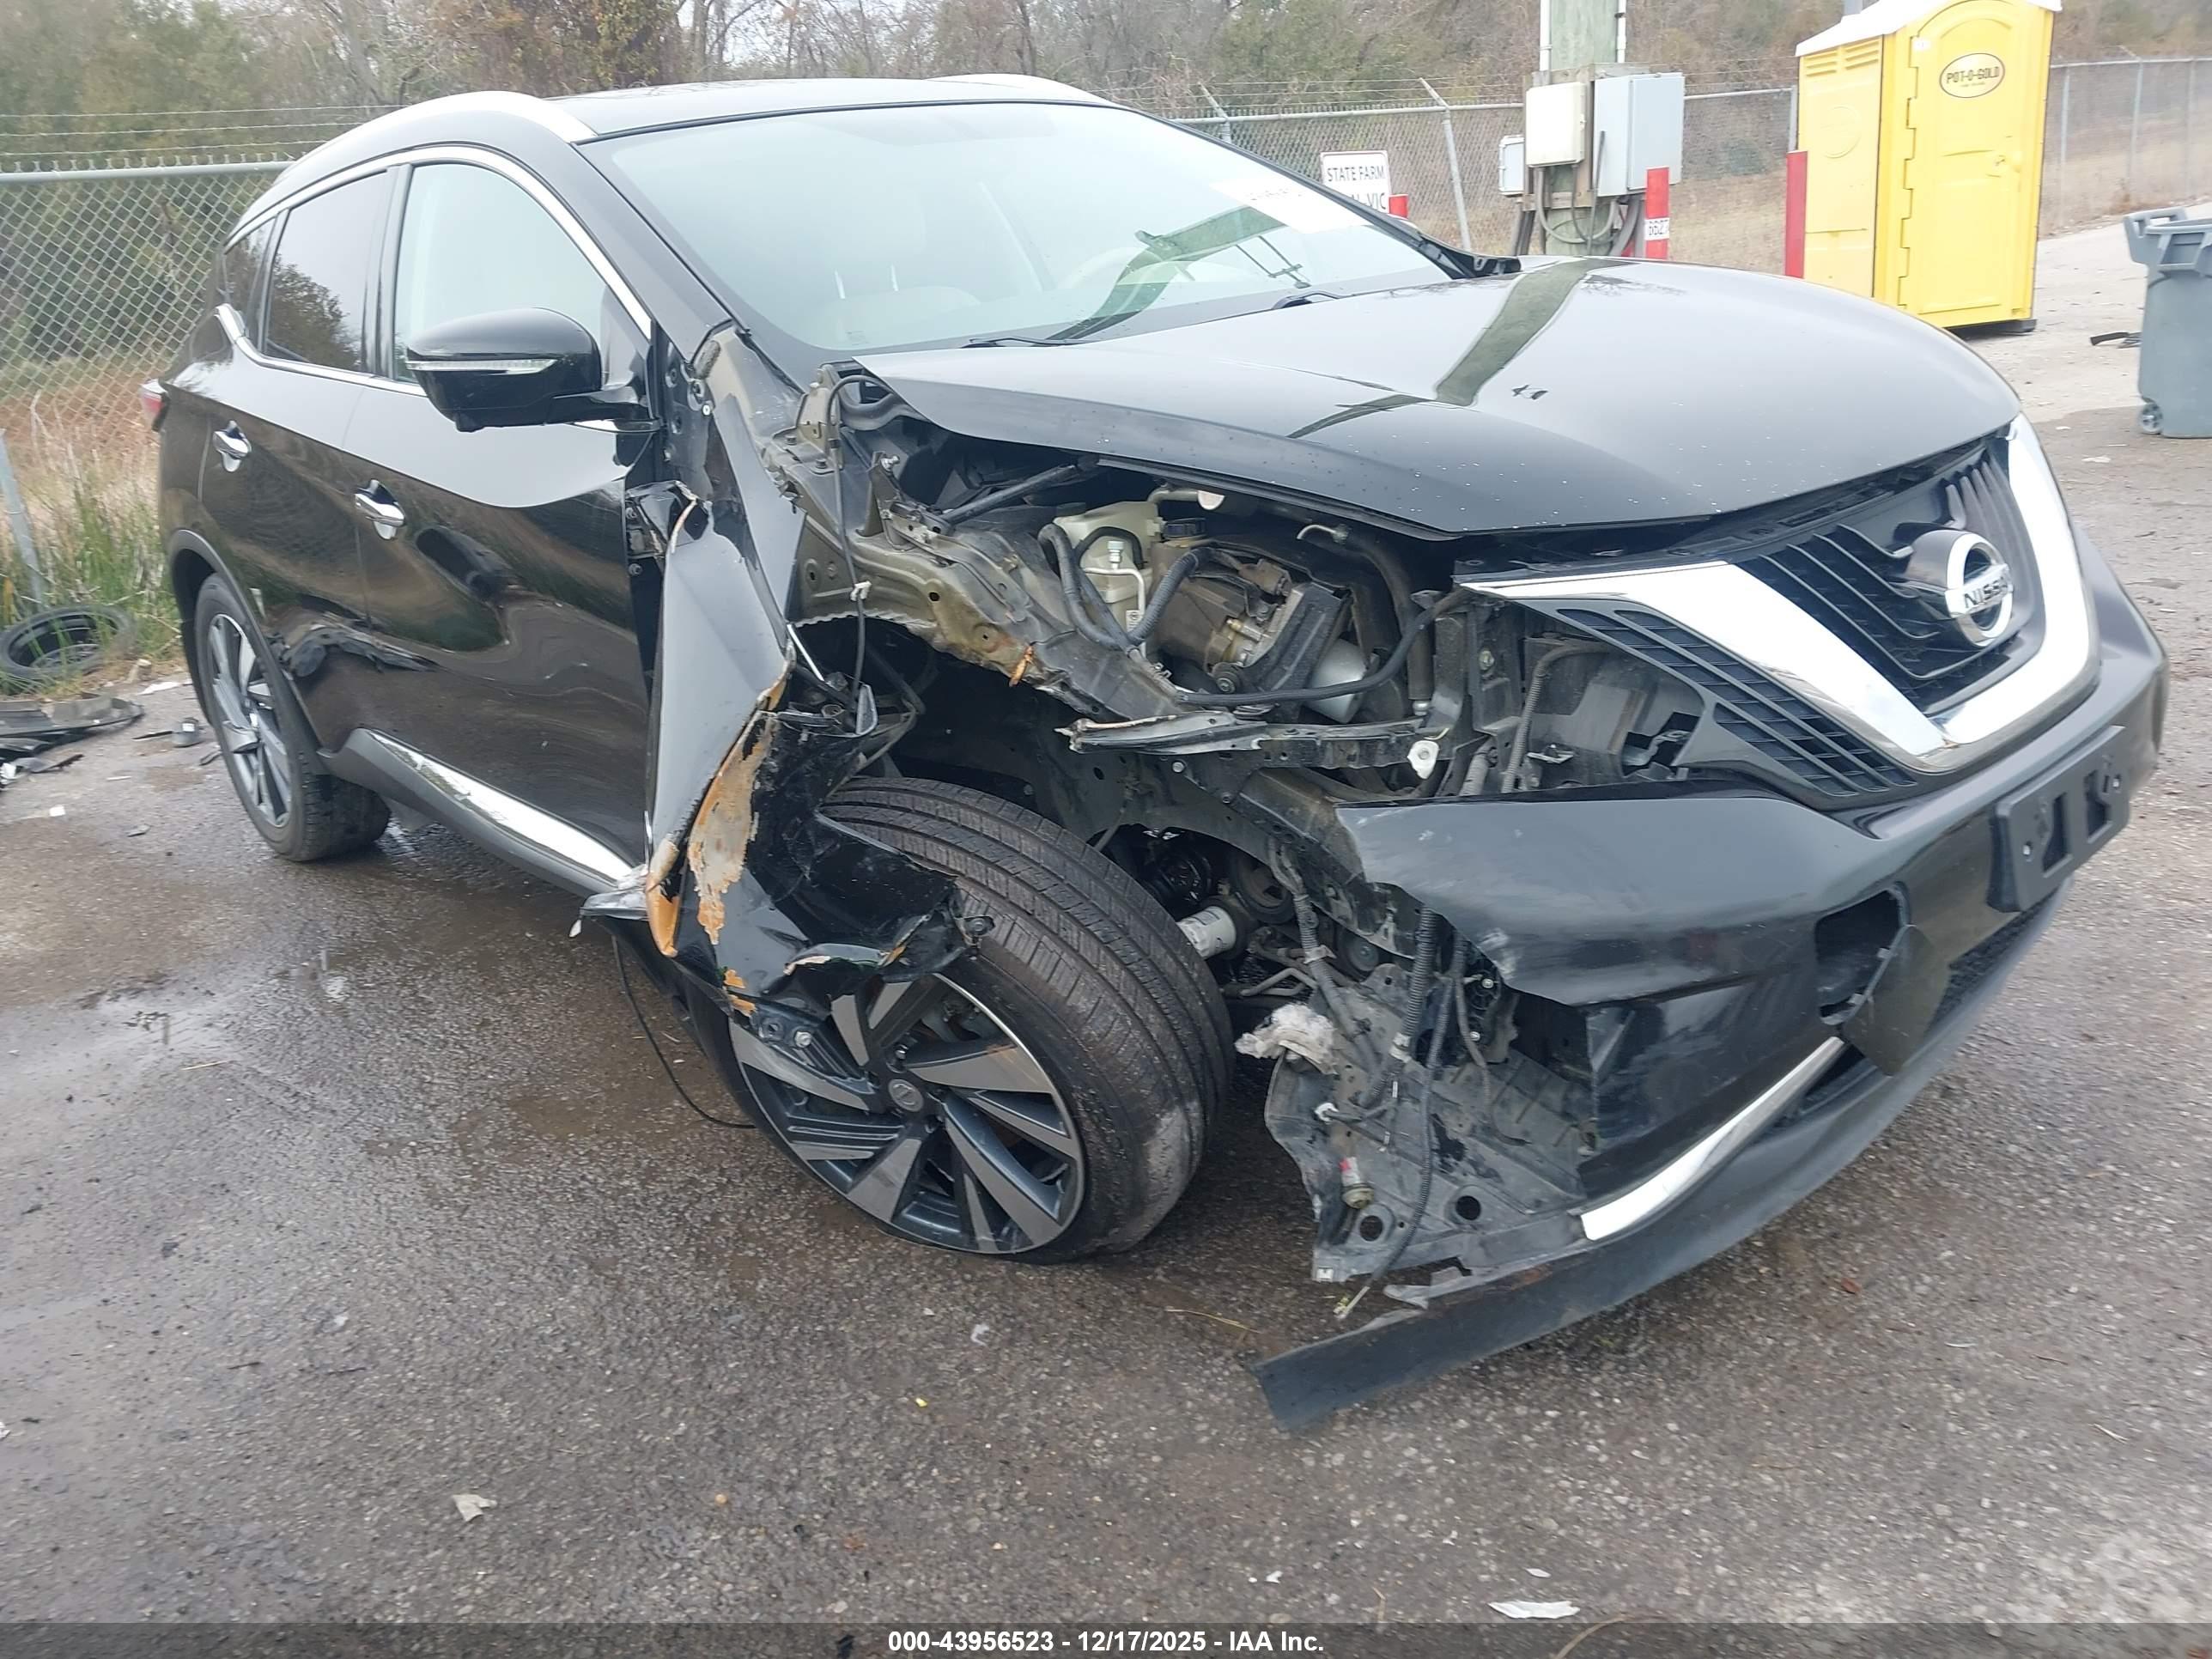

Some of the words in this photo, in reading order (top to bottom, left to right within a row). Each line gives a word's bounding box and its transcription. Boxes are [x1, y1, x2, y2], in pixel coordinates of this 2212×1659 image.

[1946, 66, 1999, 83] POT-O-GOLD
[1327, 166, 1356, 181] STATE
[1358, 165, 1385, 179] FARM
